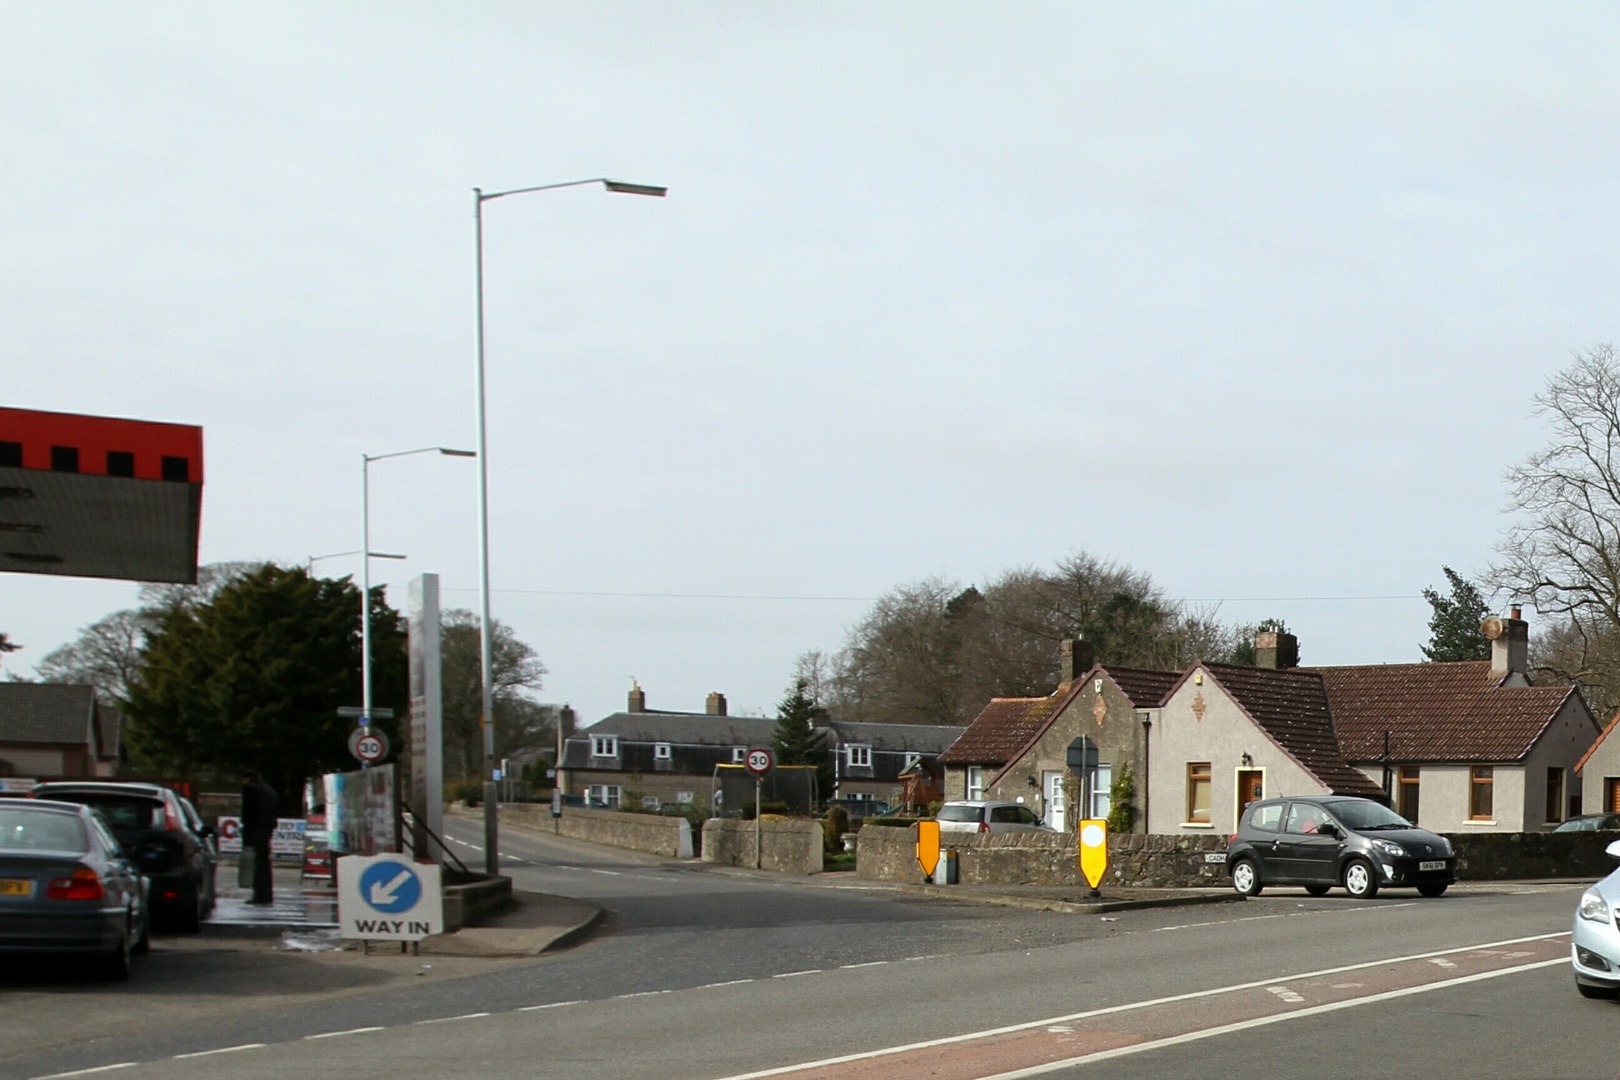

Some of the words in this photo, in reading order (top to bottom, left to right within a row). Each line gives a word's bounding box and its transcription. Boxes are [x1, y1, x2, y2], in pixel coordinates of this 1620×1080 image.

[361, 742, 379, 754] 30
[750, 755, 767, 766] 30
[354, 919, 404, 934] WAY
[408, 921, 430, 935] IN
